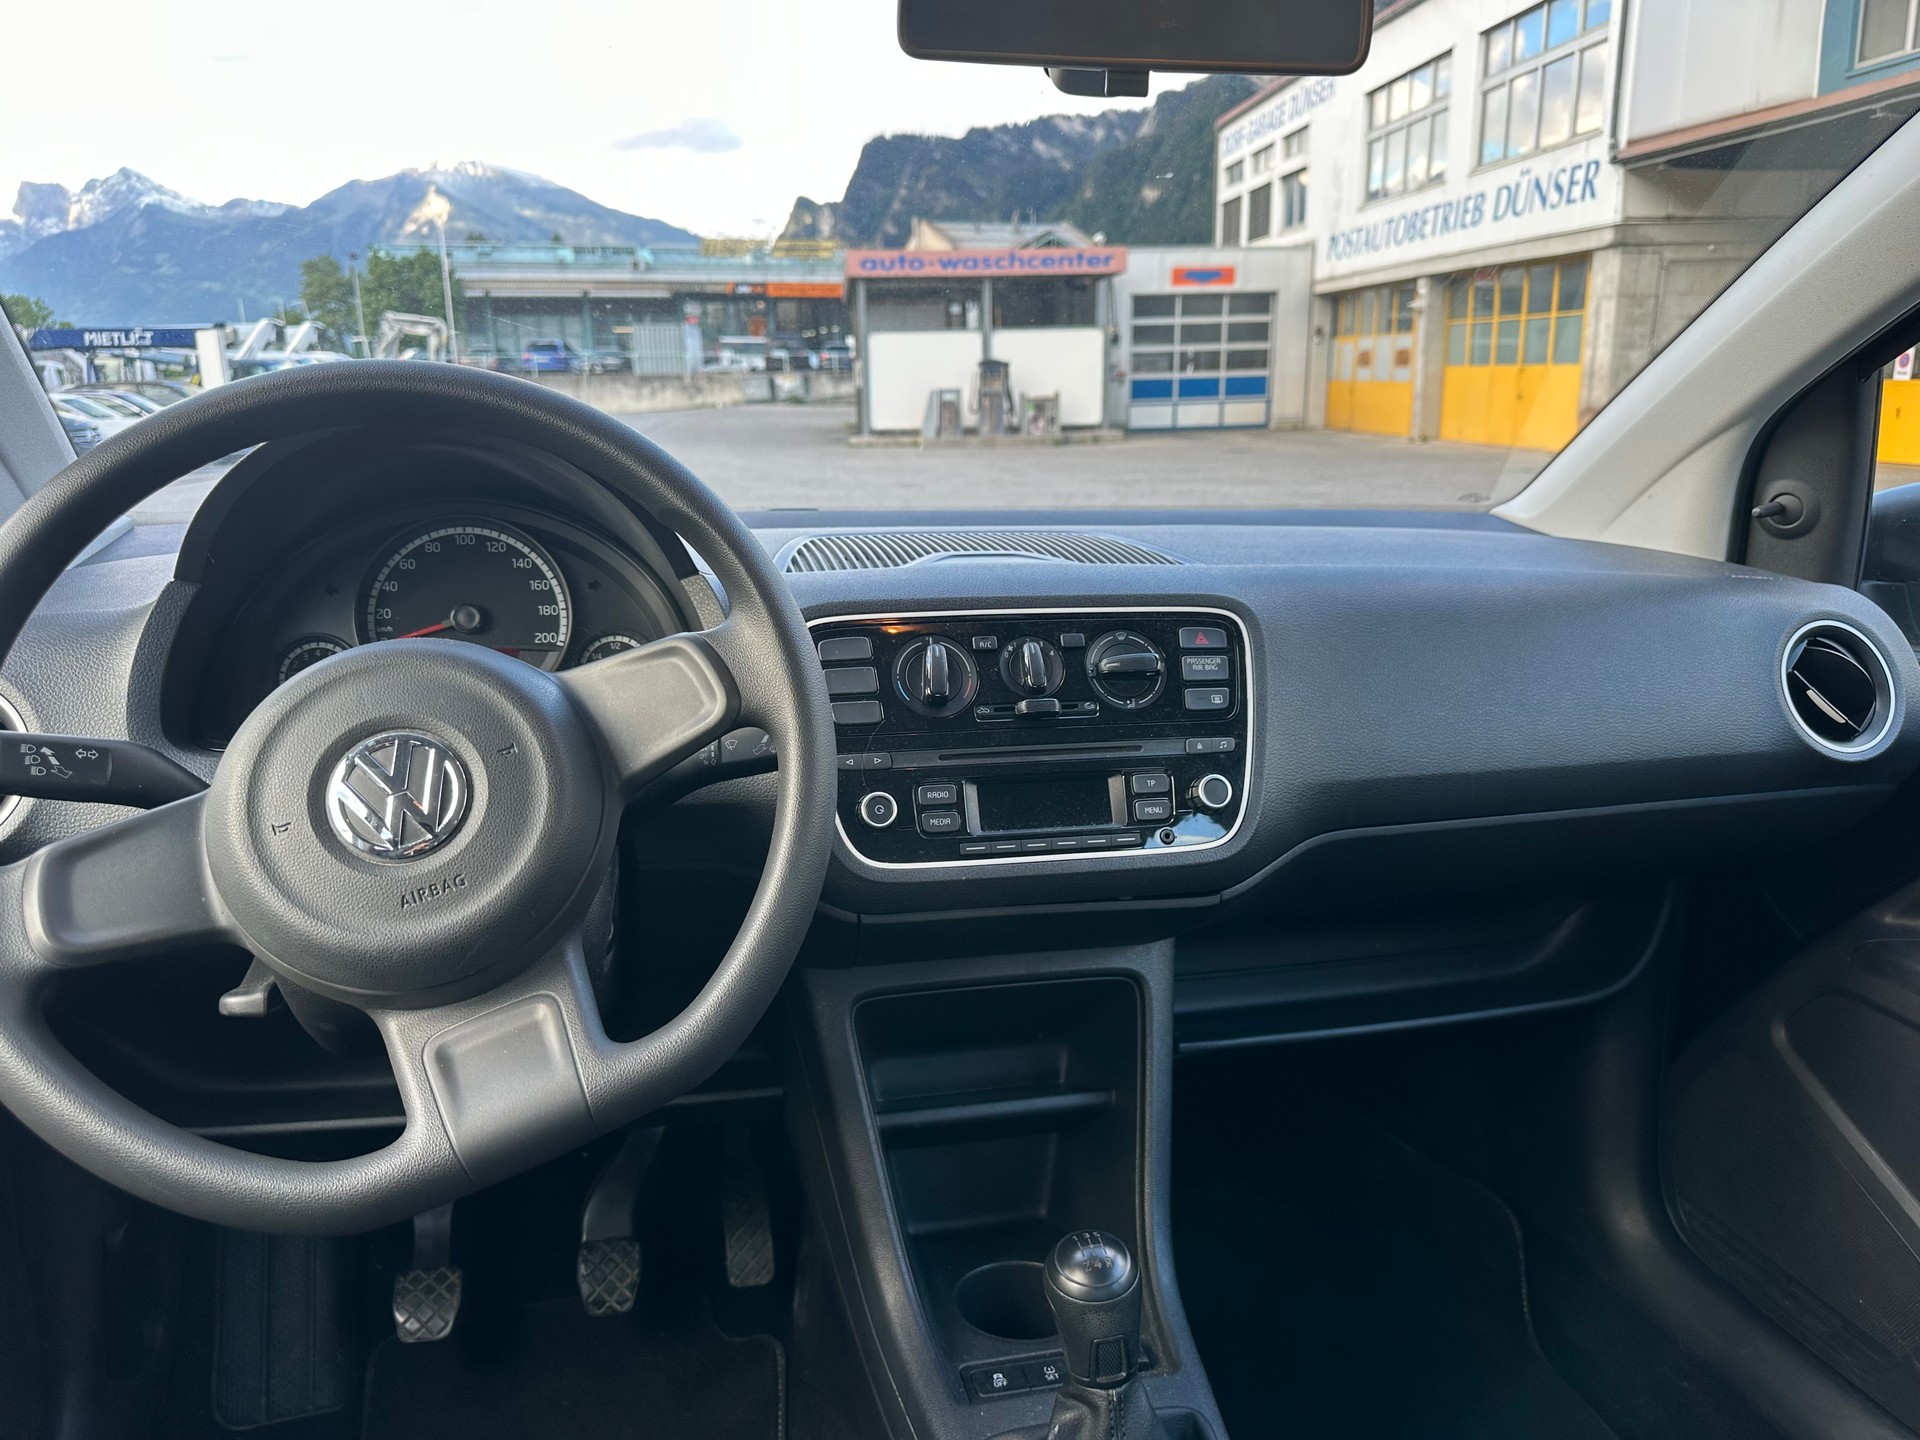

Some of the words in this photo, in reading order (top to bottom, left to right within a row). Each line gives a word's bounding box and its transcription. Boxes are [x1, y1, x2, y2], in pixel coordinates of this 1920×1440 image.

[1326, 192, 1485, 262] POSTAUTOBETRIEB
[1493, 159, 1600, 222] DÜNSER
[455, 534, 476, 545] 100
[425, 542, 441, 553] 80
[486, 541, 507, 553] 120
[400, 558, 416, 570] 60
[512, 558, 533, 569] 140
[382, 580, 398, 592] 40
[529, 580, 550, 591] 160
[376, 608, 392, 619] 20
[537, 605, 559, 616] 180
[534, 632, 558, 644] 200
[610, 642, 621, 650] 1/2
[1186, 657, 1221, 665] PASSENGER
[1146, 779, 1156, 787] TP
[927, 790, 949, 799] RADIO
[1144, 806, 1163, 814] MENU
[929, 817, 951, 826] MEDIA
[400, 873, 468, 910] AIRBAG
[1044, 1373, 1059, 1381] SET
[993, 1380, 1008, 1388] OFF
